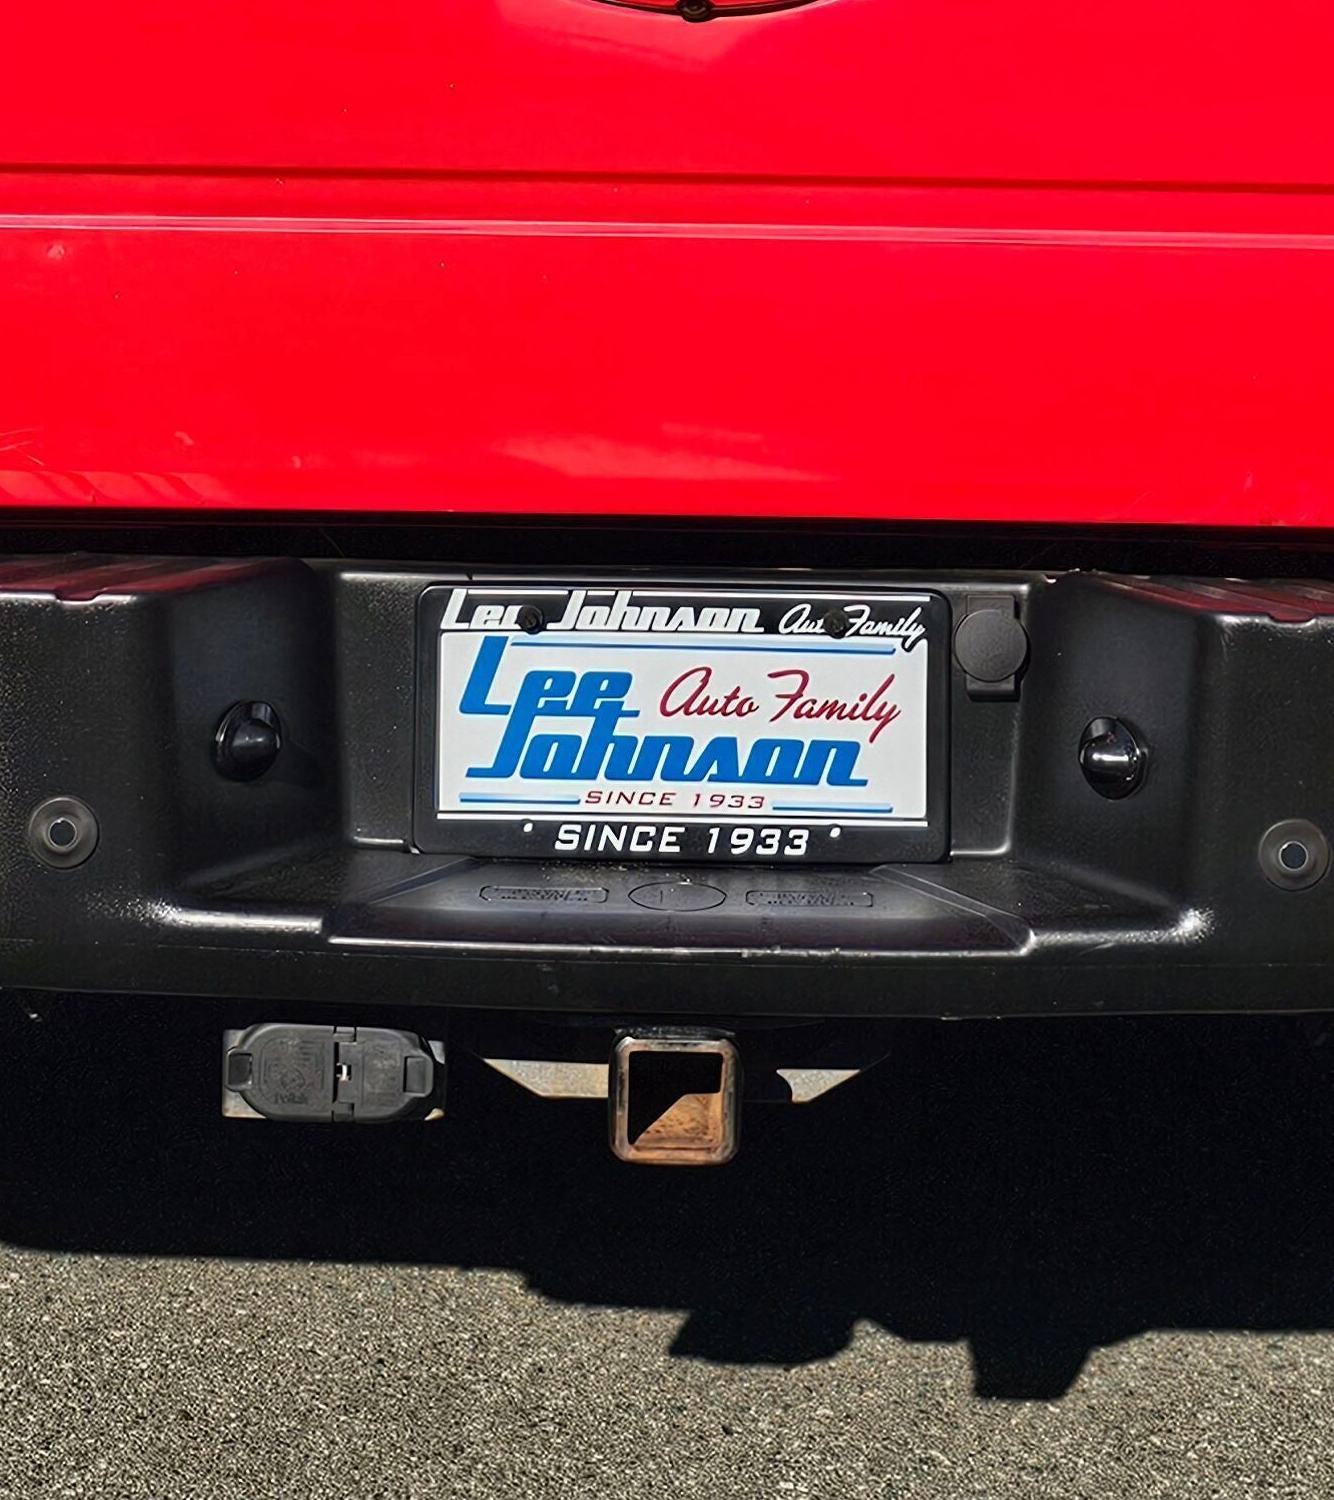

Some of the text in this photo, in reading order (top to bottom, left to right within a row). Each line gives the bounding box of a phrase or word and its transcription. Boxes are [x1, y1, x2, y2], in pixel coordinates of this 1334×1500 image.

[546, 590, 765, 633] Johnson
[844, 604, 926, 650] Family
[459, 636, 640, 717] Lee
[659, 666, 902, 744] Auto Family
[466, 707, 869, 787] Johnson
[585, 790, 765, 810] SINCE 1933
[554, 824, 809, 856] SINCE 1933
